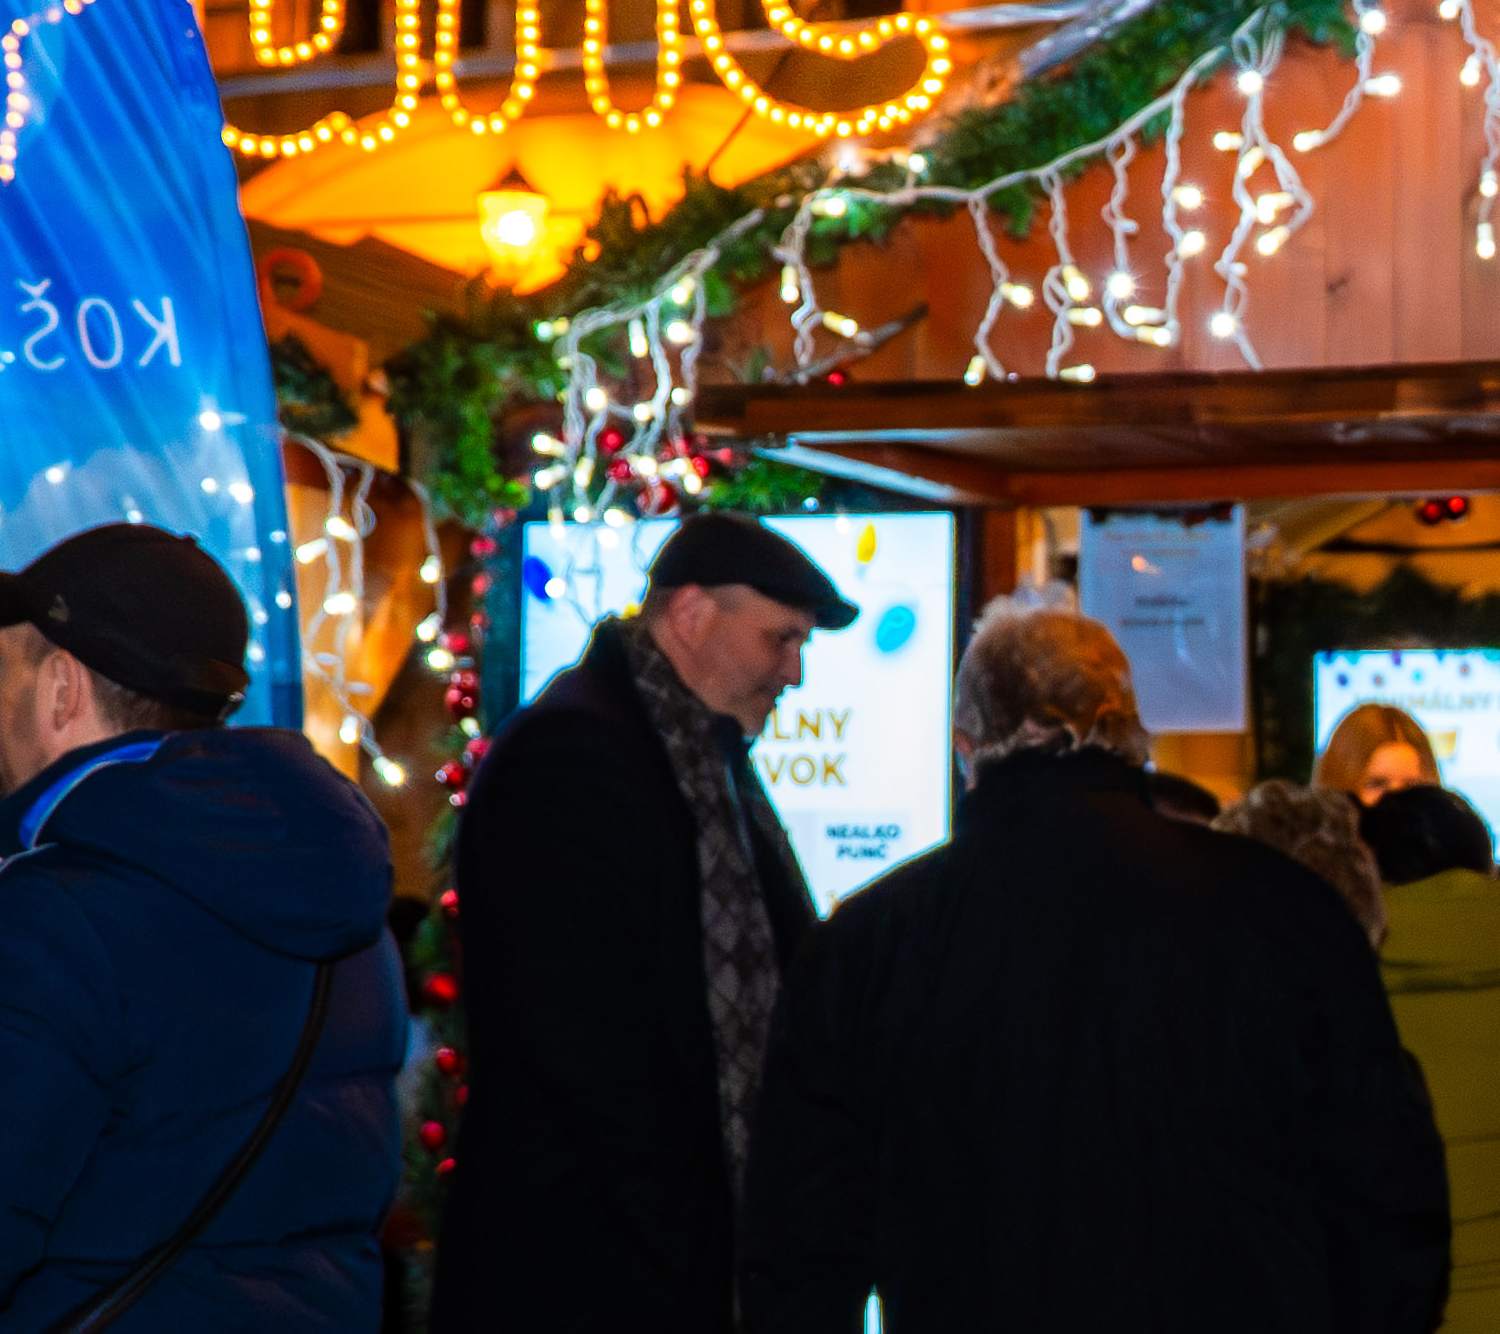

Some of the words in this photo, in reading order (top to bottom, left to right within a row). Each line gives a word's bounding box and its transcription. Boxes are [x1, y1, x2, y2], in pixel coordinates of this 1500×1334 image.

[770, 708, 850, 740] LNY
[761, 754, 846, 785] VOK
[825, 824, 902, 840] NEALKO
[836, 838, 887, 859] PUNČ
